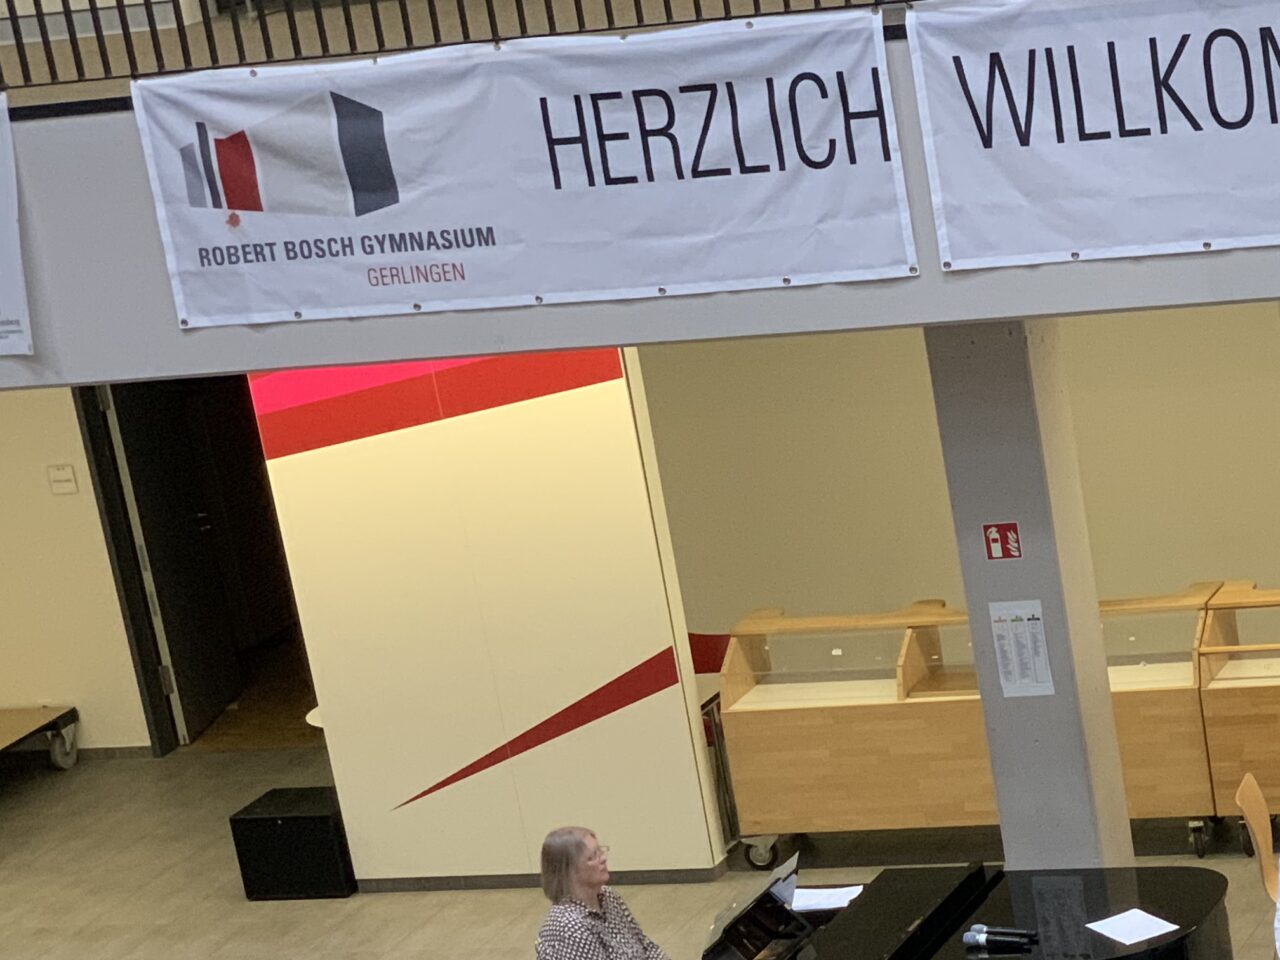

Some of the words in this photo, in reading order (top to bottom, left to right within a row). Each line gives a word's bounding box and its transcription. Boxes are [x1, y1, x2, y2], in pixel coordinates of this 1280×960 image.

[540, 66, 891, 190] HERZLICH
[199, 241, 278, 267] ROBERT
[283, 236, 355, 262] BOSCH
[360, 226, 497, 256] GYMNASIUM
[367, 262, 466, 287] GERLINGEN
